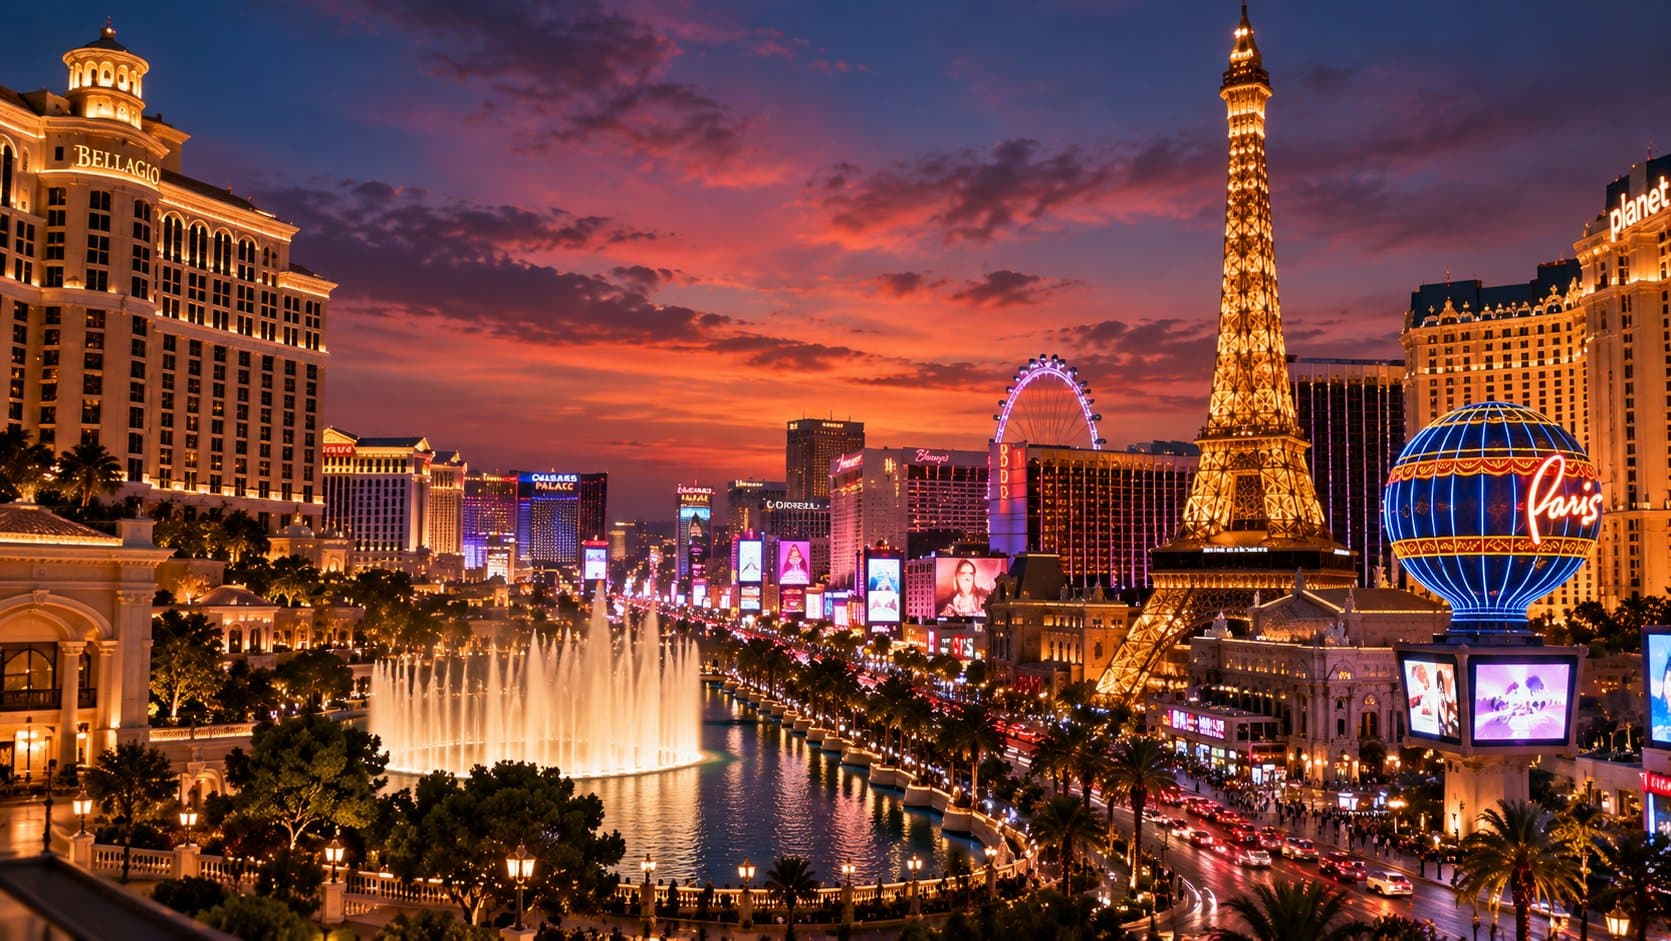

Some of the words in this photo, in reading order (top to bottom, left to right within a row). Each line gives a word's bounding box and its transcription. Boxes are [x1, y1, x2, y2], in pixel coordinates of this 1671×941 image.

[73, 144, 160, 185] BELLAGIO
[1609, 175, 1670, 243] planet
[1527, 454, 1604, 545] Paris
